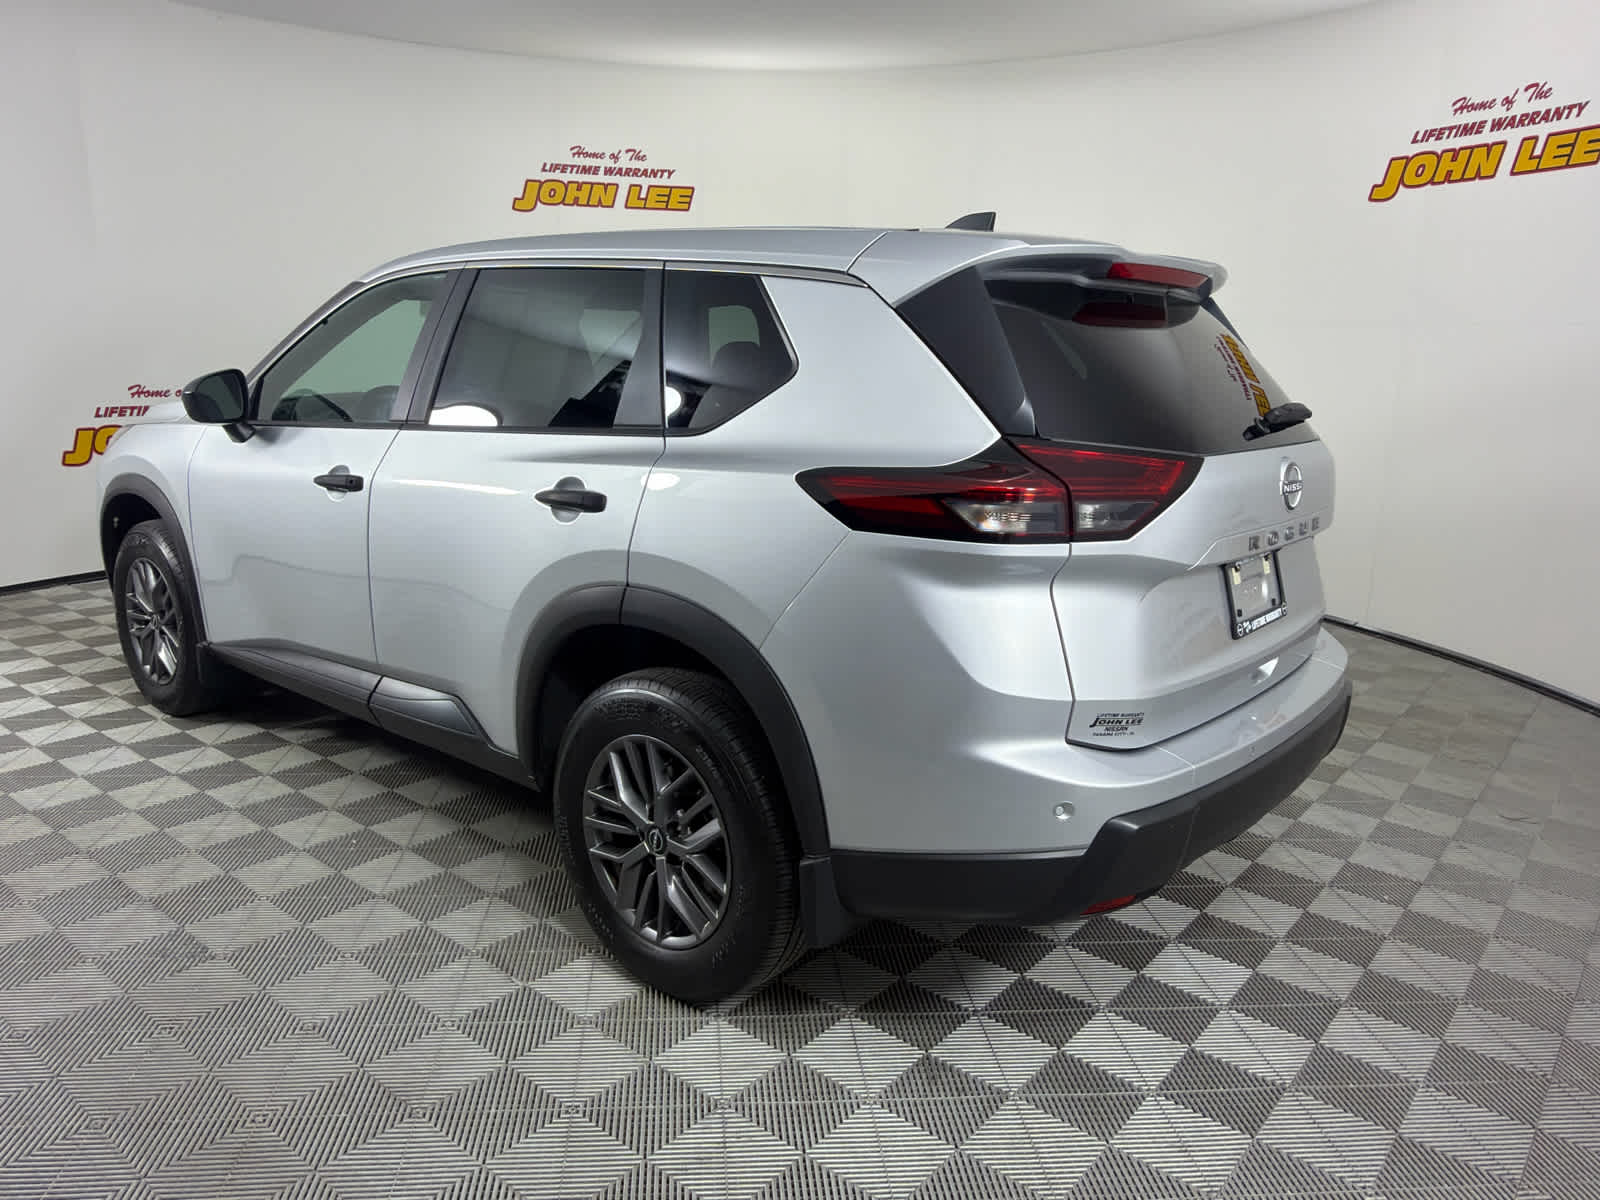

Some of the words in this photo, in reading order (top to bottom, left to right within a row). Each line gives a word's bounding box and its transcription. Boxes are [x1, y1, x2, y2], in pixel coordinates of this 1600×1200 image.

[1452, 96, 1497, 116] Home
[1501, 88, 1519, 111] of
[1524, 81, 1553, 103] The
[1411, 119, 1488, 144] LIFETIME
[1489, 100, 1591, 132] WARRANTY
[541, 162, 600, 175] LIFETIME
[603, 166, 675, 179] WARRANTY
[570, 145, 605, 159] Home
[609, 150, 621, 163] of
[625, 149, 647, 162] The
[1368, 140, 1507, 202] JOHN
[1509, 124, 1600, 176] LEE
[512, 179, 619, 212] JOHN
[625, 183, 695, 211] LEE
[128, 384, 171, 398] Home
[175, 389, 182, 397] o
[94, 405, 150, 418] LIFETI
[62, 424, 122, 467] JO
[1248, 516, 1320, 551] ROGUE
[1089, 717, 1123, 728] JOHN
